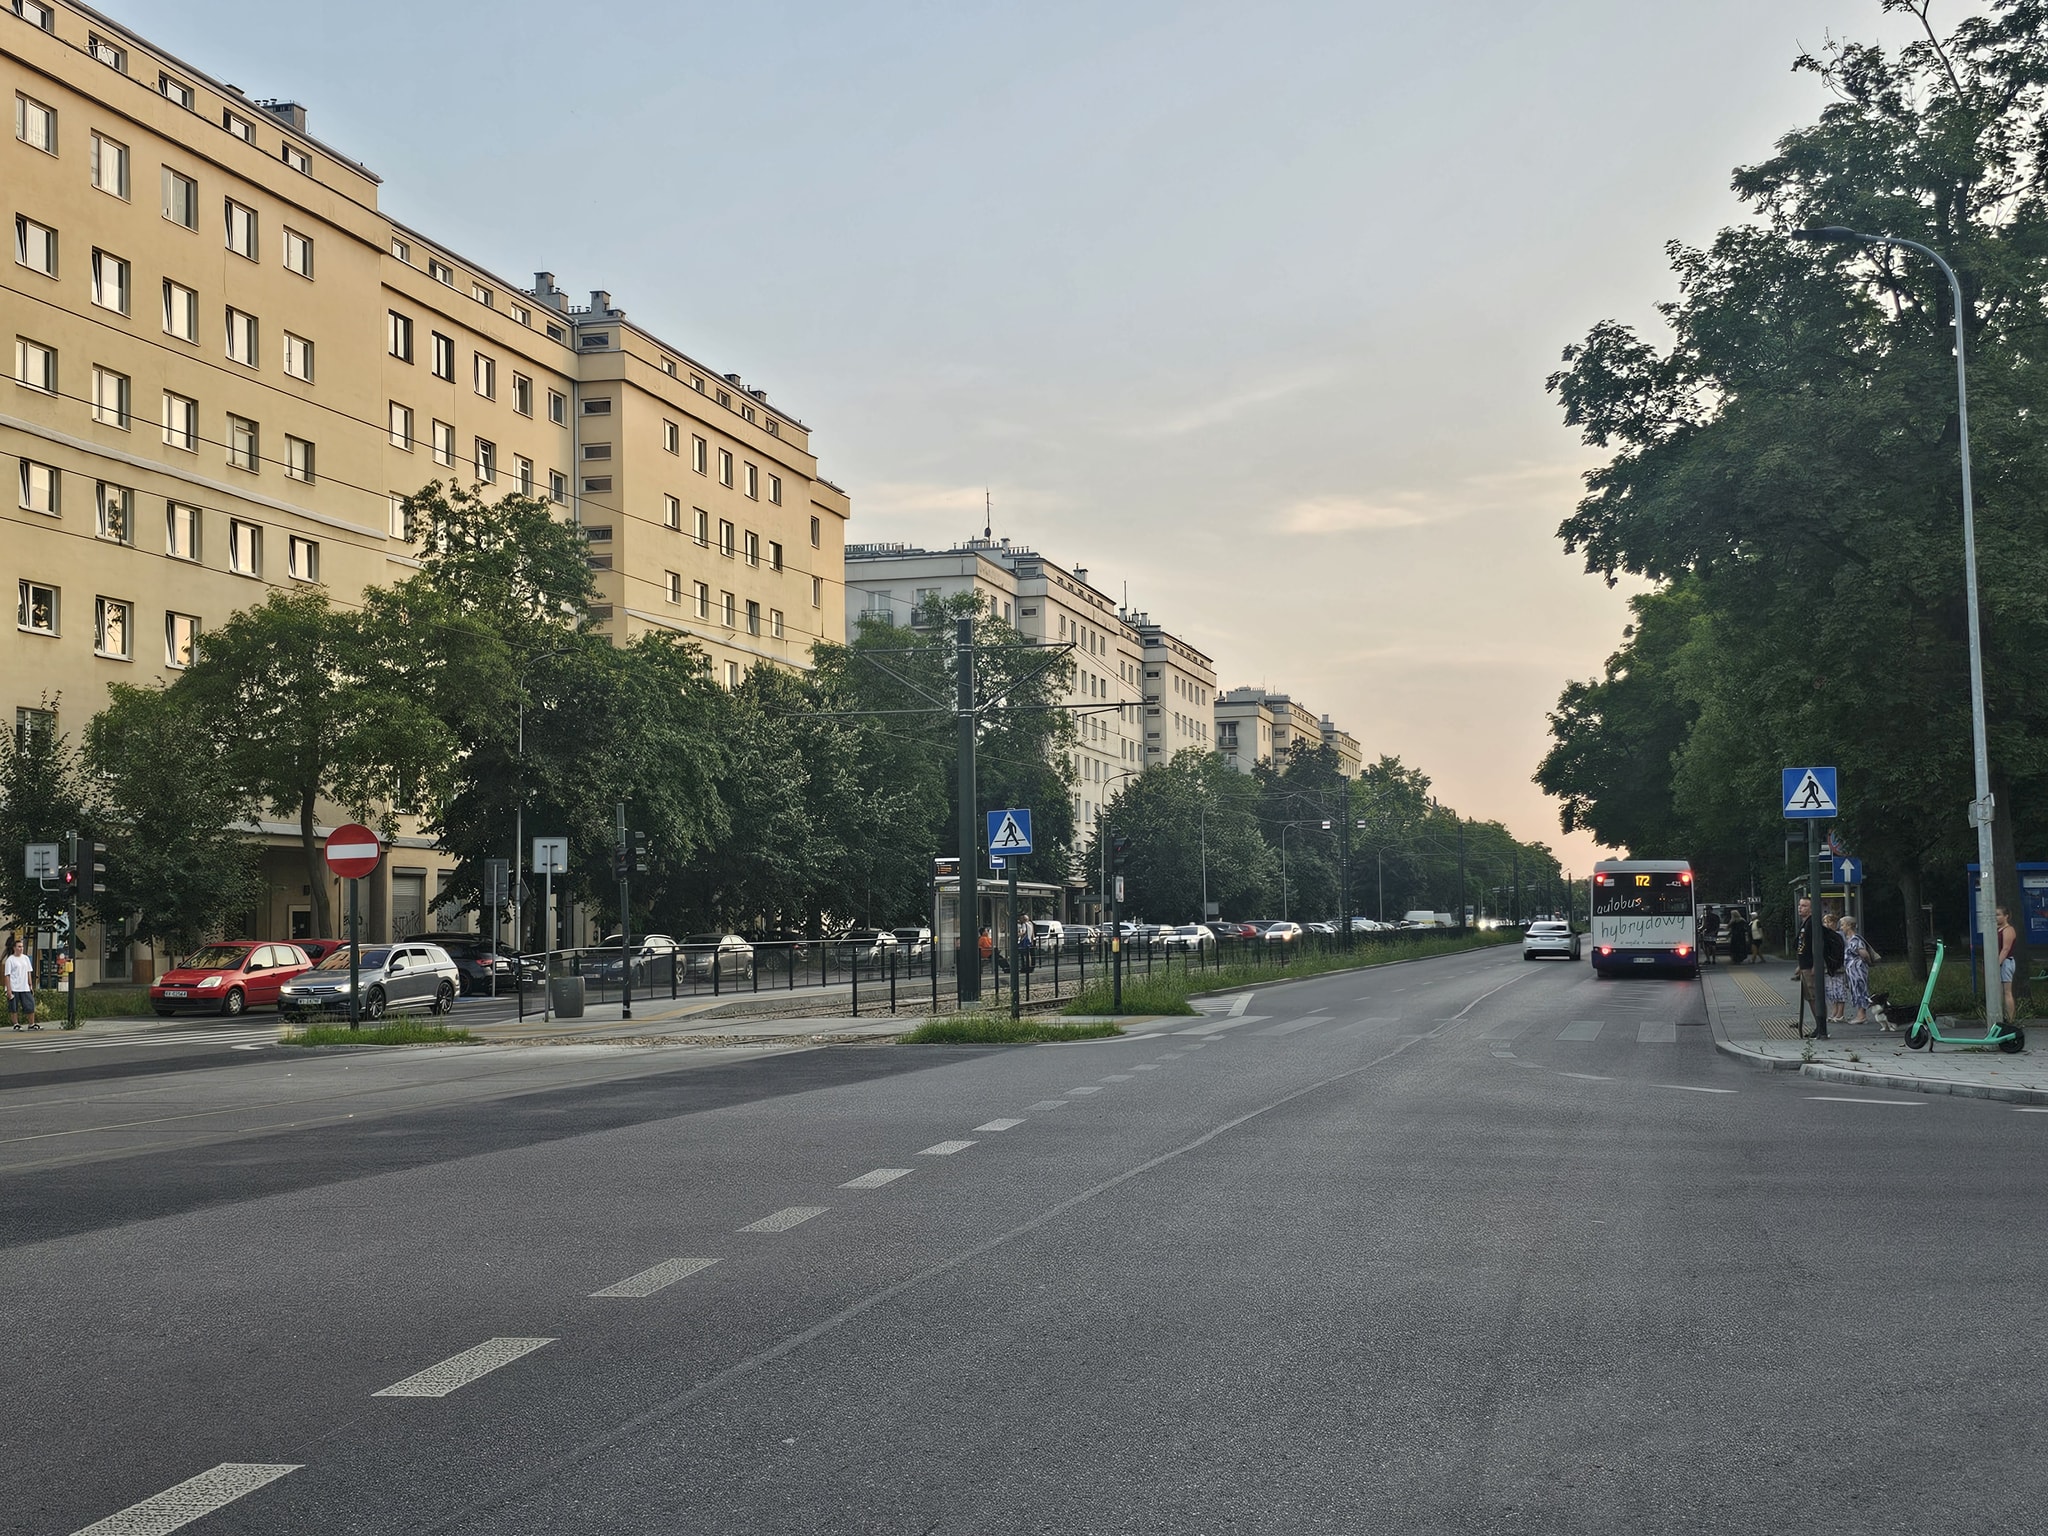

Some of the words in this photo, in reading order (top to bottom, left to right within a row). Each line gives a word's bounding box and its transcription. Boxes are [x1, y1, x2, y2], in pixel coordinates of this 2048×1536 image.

[1635, 875, 1650, 887] 172
[1596, 894, 1642, 914] autobus
[1601, 916, 1685, 943] hybrydowy
